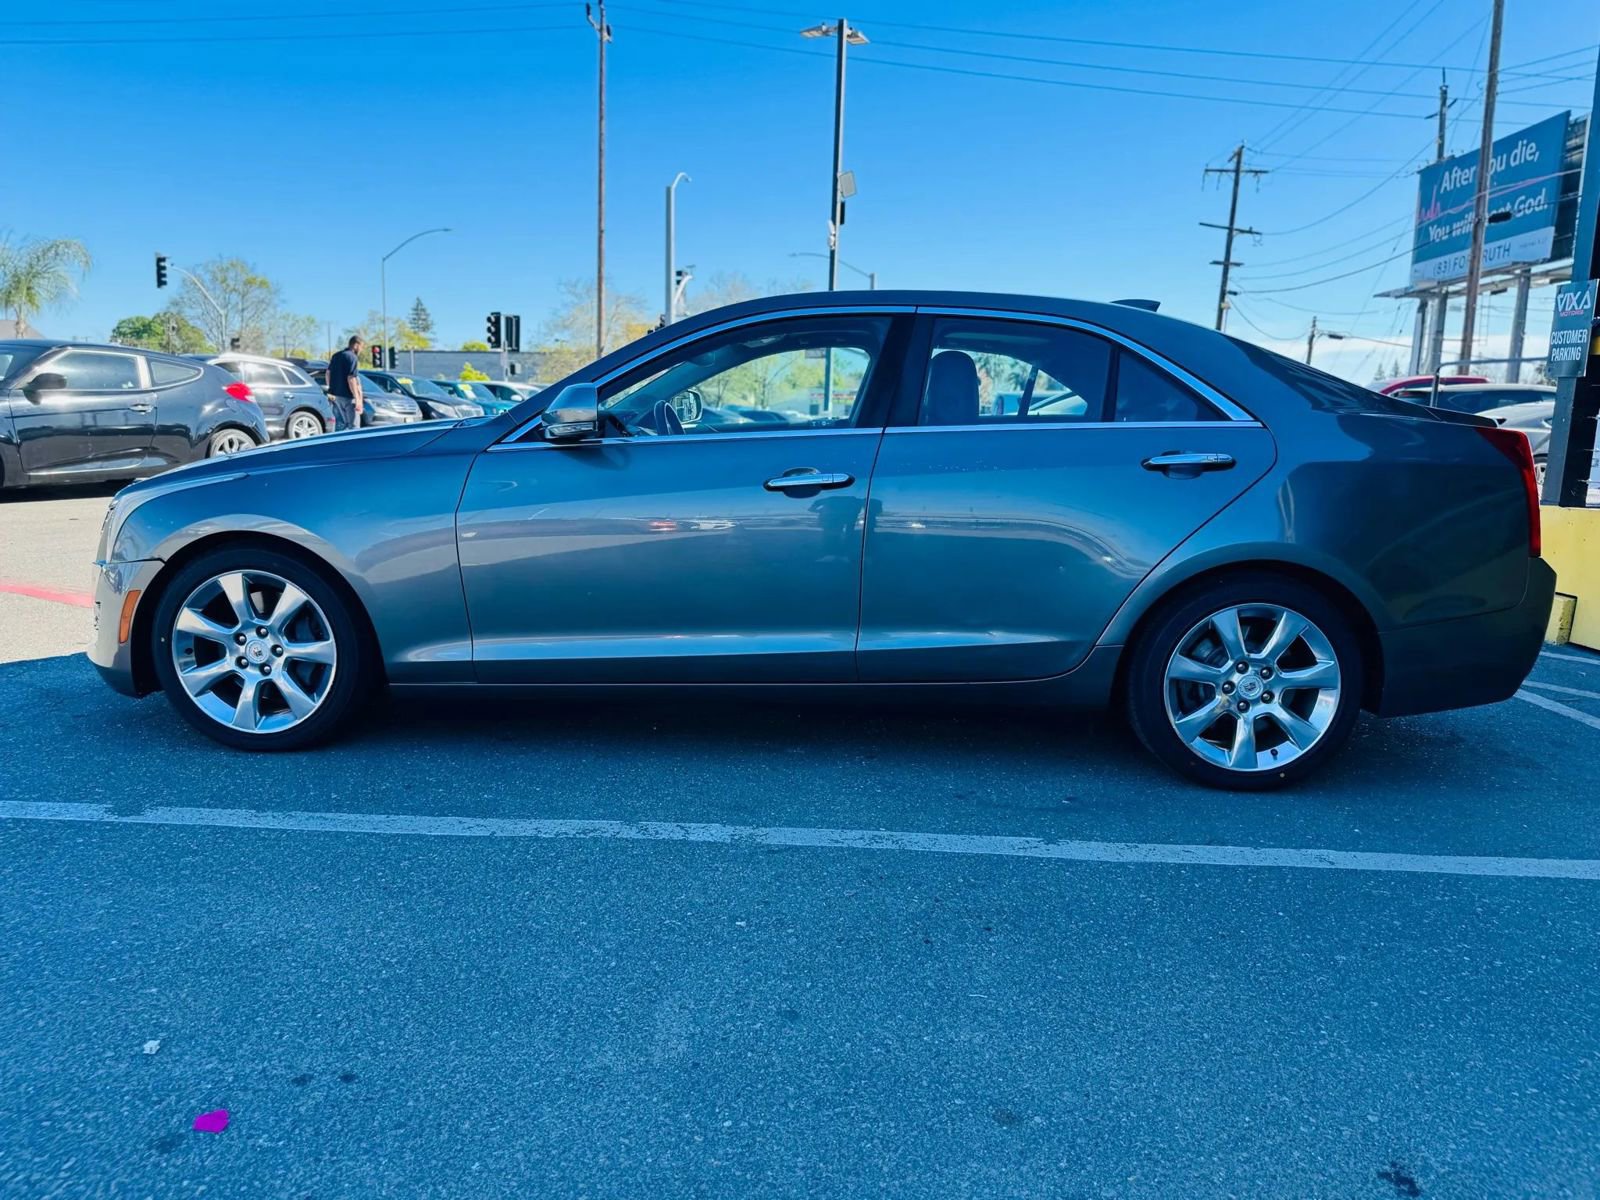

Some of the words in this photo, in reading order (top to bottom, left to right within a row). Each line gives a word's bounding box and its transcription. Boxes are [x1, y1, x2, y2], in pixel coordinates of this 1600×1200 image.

[1440, 165, 1476, 194] After
[1487, 153, 1507, 177] ou
[1510, 139, 1540, 167] die,
[1429, 224, 1450, 242] You
[1514, 188, 1548, 218] God.
[1482, 242, 1512, 263] RUTH
[1557, 290, 1592, 312] VIXA
[1551, 328, 1588, 345] CUSTOMER
[1551, 346, 1582, 362] PARKING
